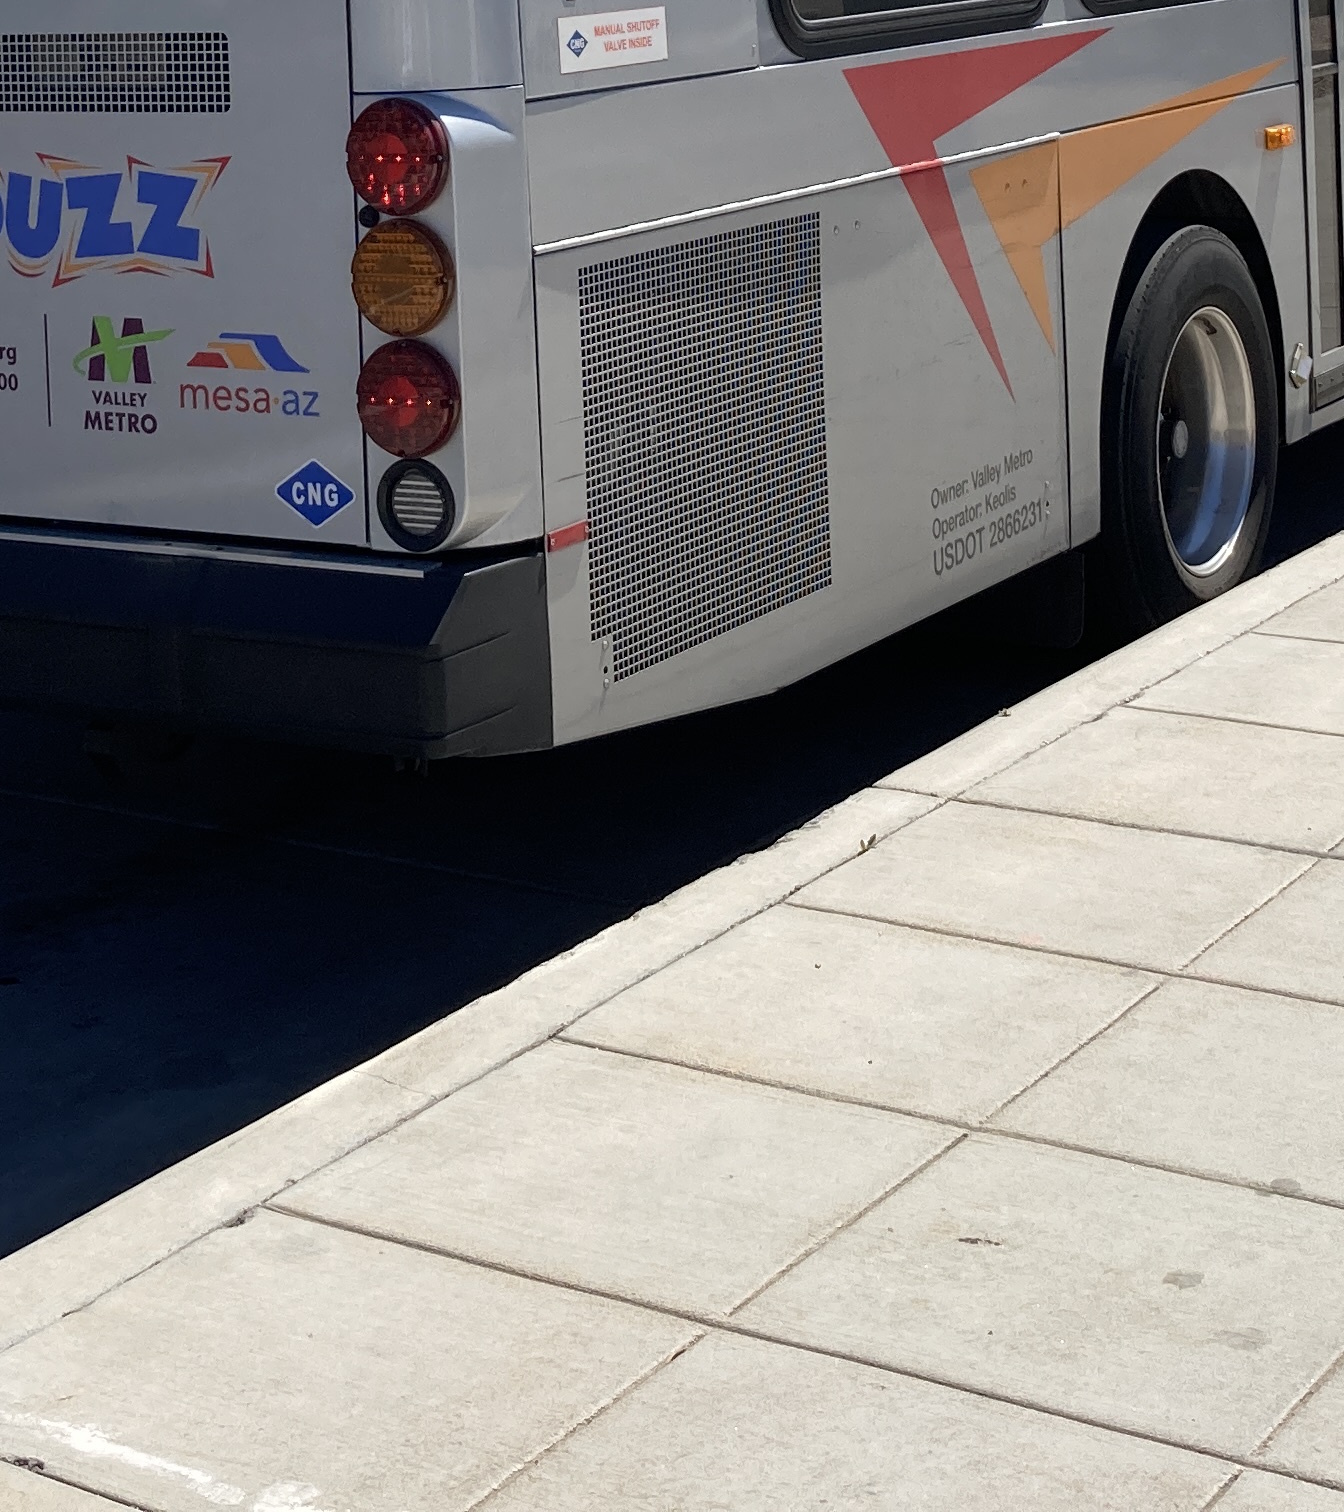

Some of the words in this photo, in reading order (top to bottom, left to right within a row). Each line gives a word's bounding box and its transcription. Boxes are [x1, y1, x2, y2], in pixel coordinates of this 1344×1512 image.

[593, 23, 626, 38] MANUAL
[627, 18, 660, 33] SHUTOFF
[603, 39, 628, 52] VALVE
[629, 36, 653, 49] INSIDE
[91, 389, 148, 408] VALLEY
[83, 409, 158, 435] METRO
[930, 478, 970, 510] Owner:
[971, 462, 1002, 492] Valley
[1003, 448, 1034, 476] Metro
[290, 480, 340, 508] CNG
[932, 500, 983, 541] Operator:
[984, 483, 1017, 516] Keolis
[932, 525, 986, 577] USDOT
[988, 497, 1043, 549] 2866231
